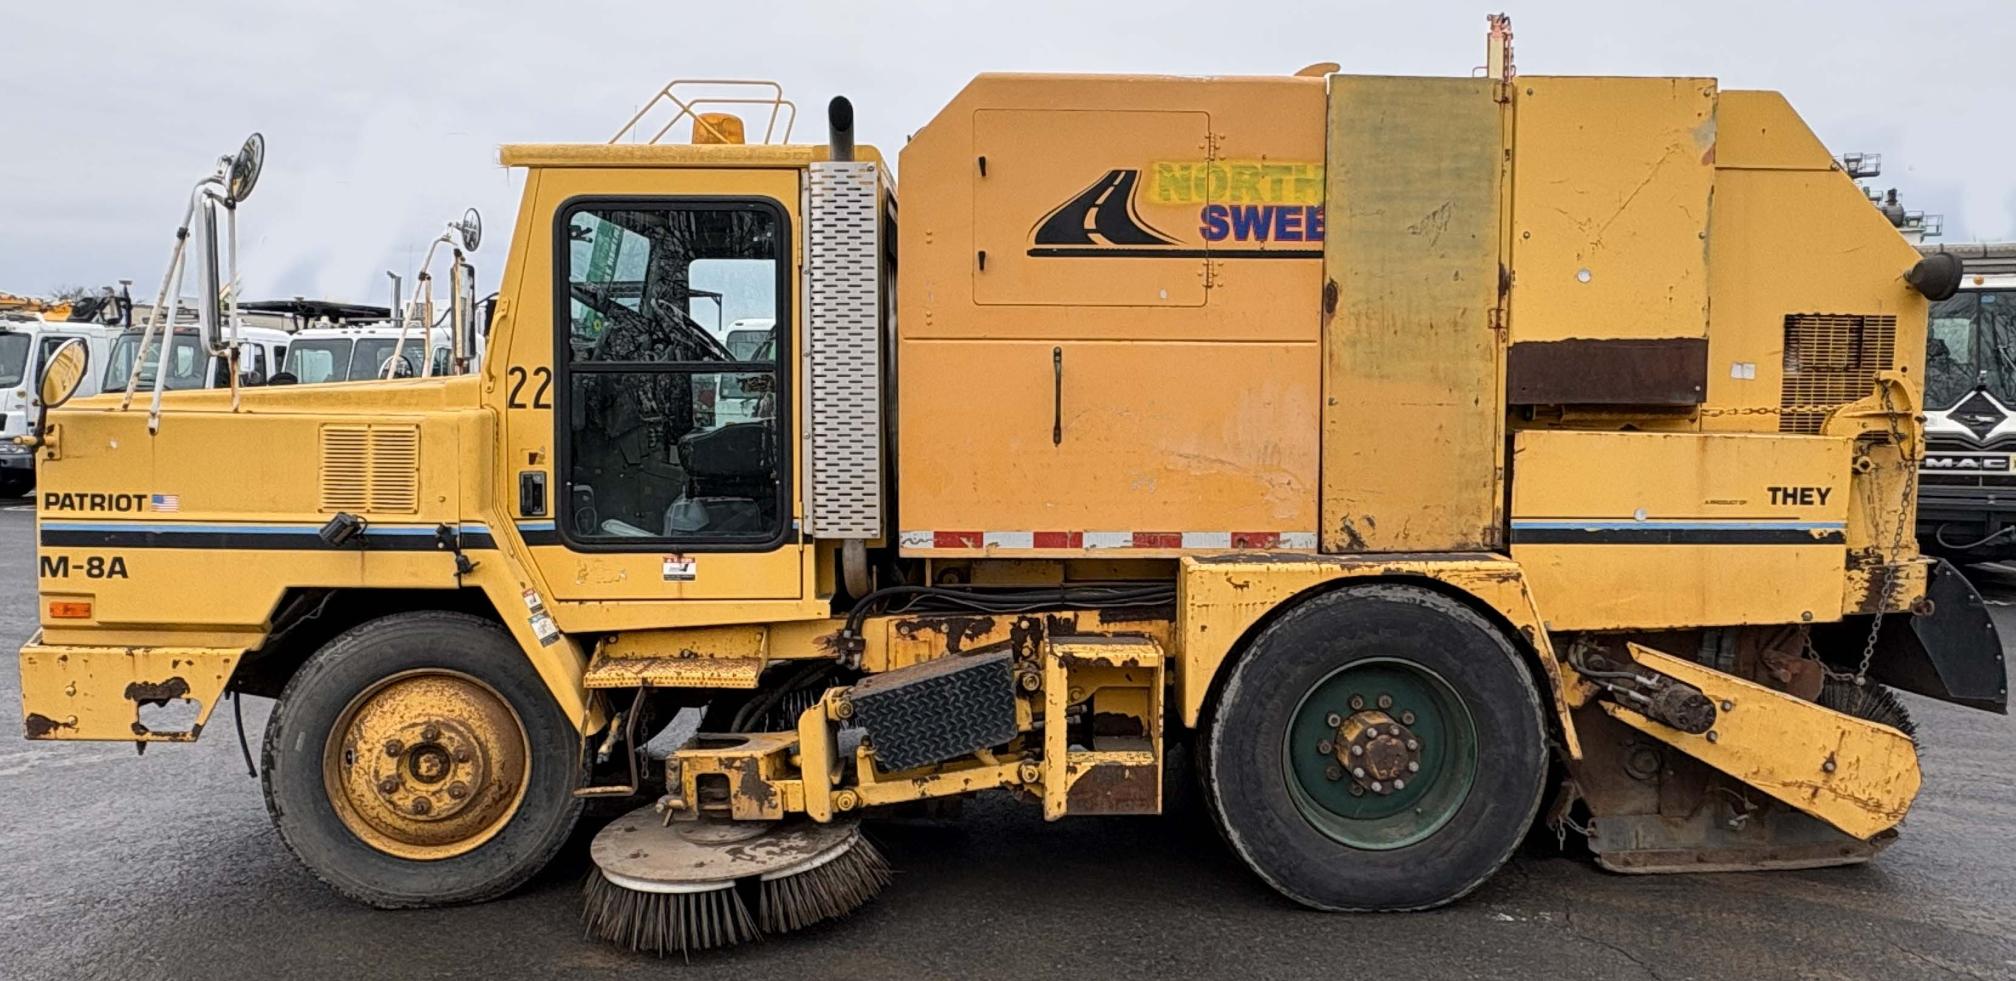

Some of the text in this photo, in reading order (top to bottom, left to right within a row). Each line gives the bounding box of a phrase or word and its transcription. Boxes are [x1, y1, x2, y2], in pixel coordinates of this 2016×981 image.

[1199, 204, 1325, 242] SWEE
[508, 366, 552, 410] 22
[44, 492, 148, 513] PATRIOT
[1766, 486, 1832, 506] THEY
[40, 555, 128, 579] M-8A
